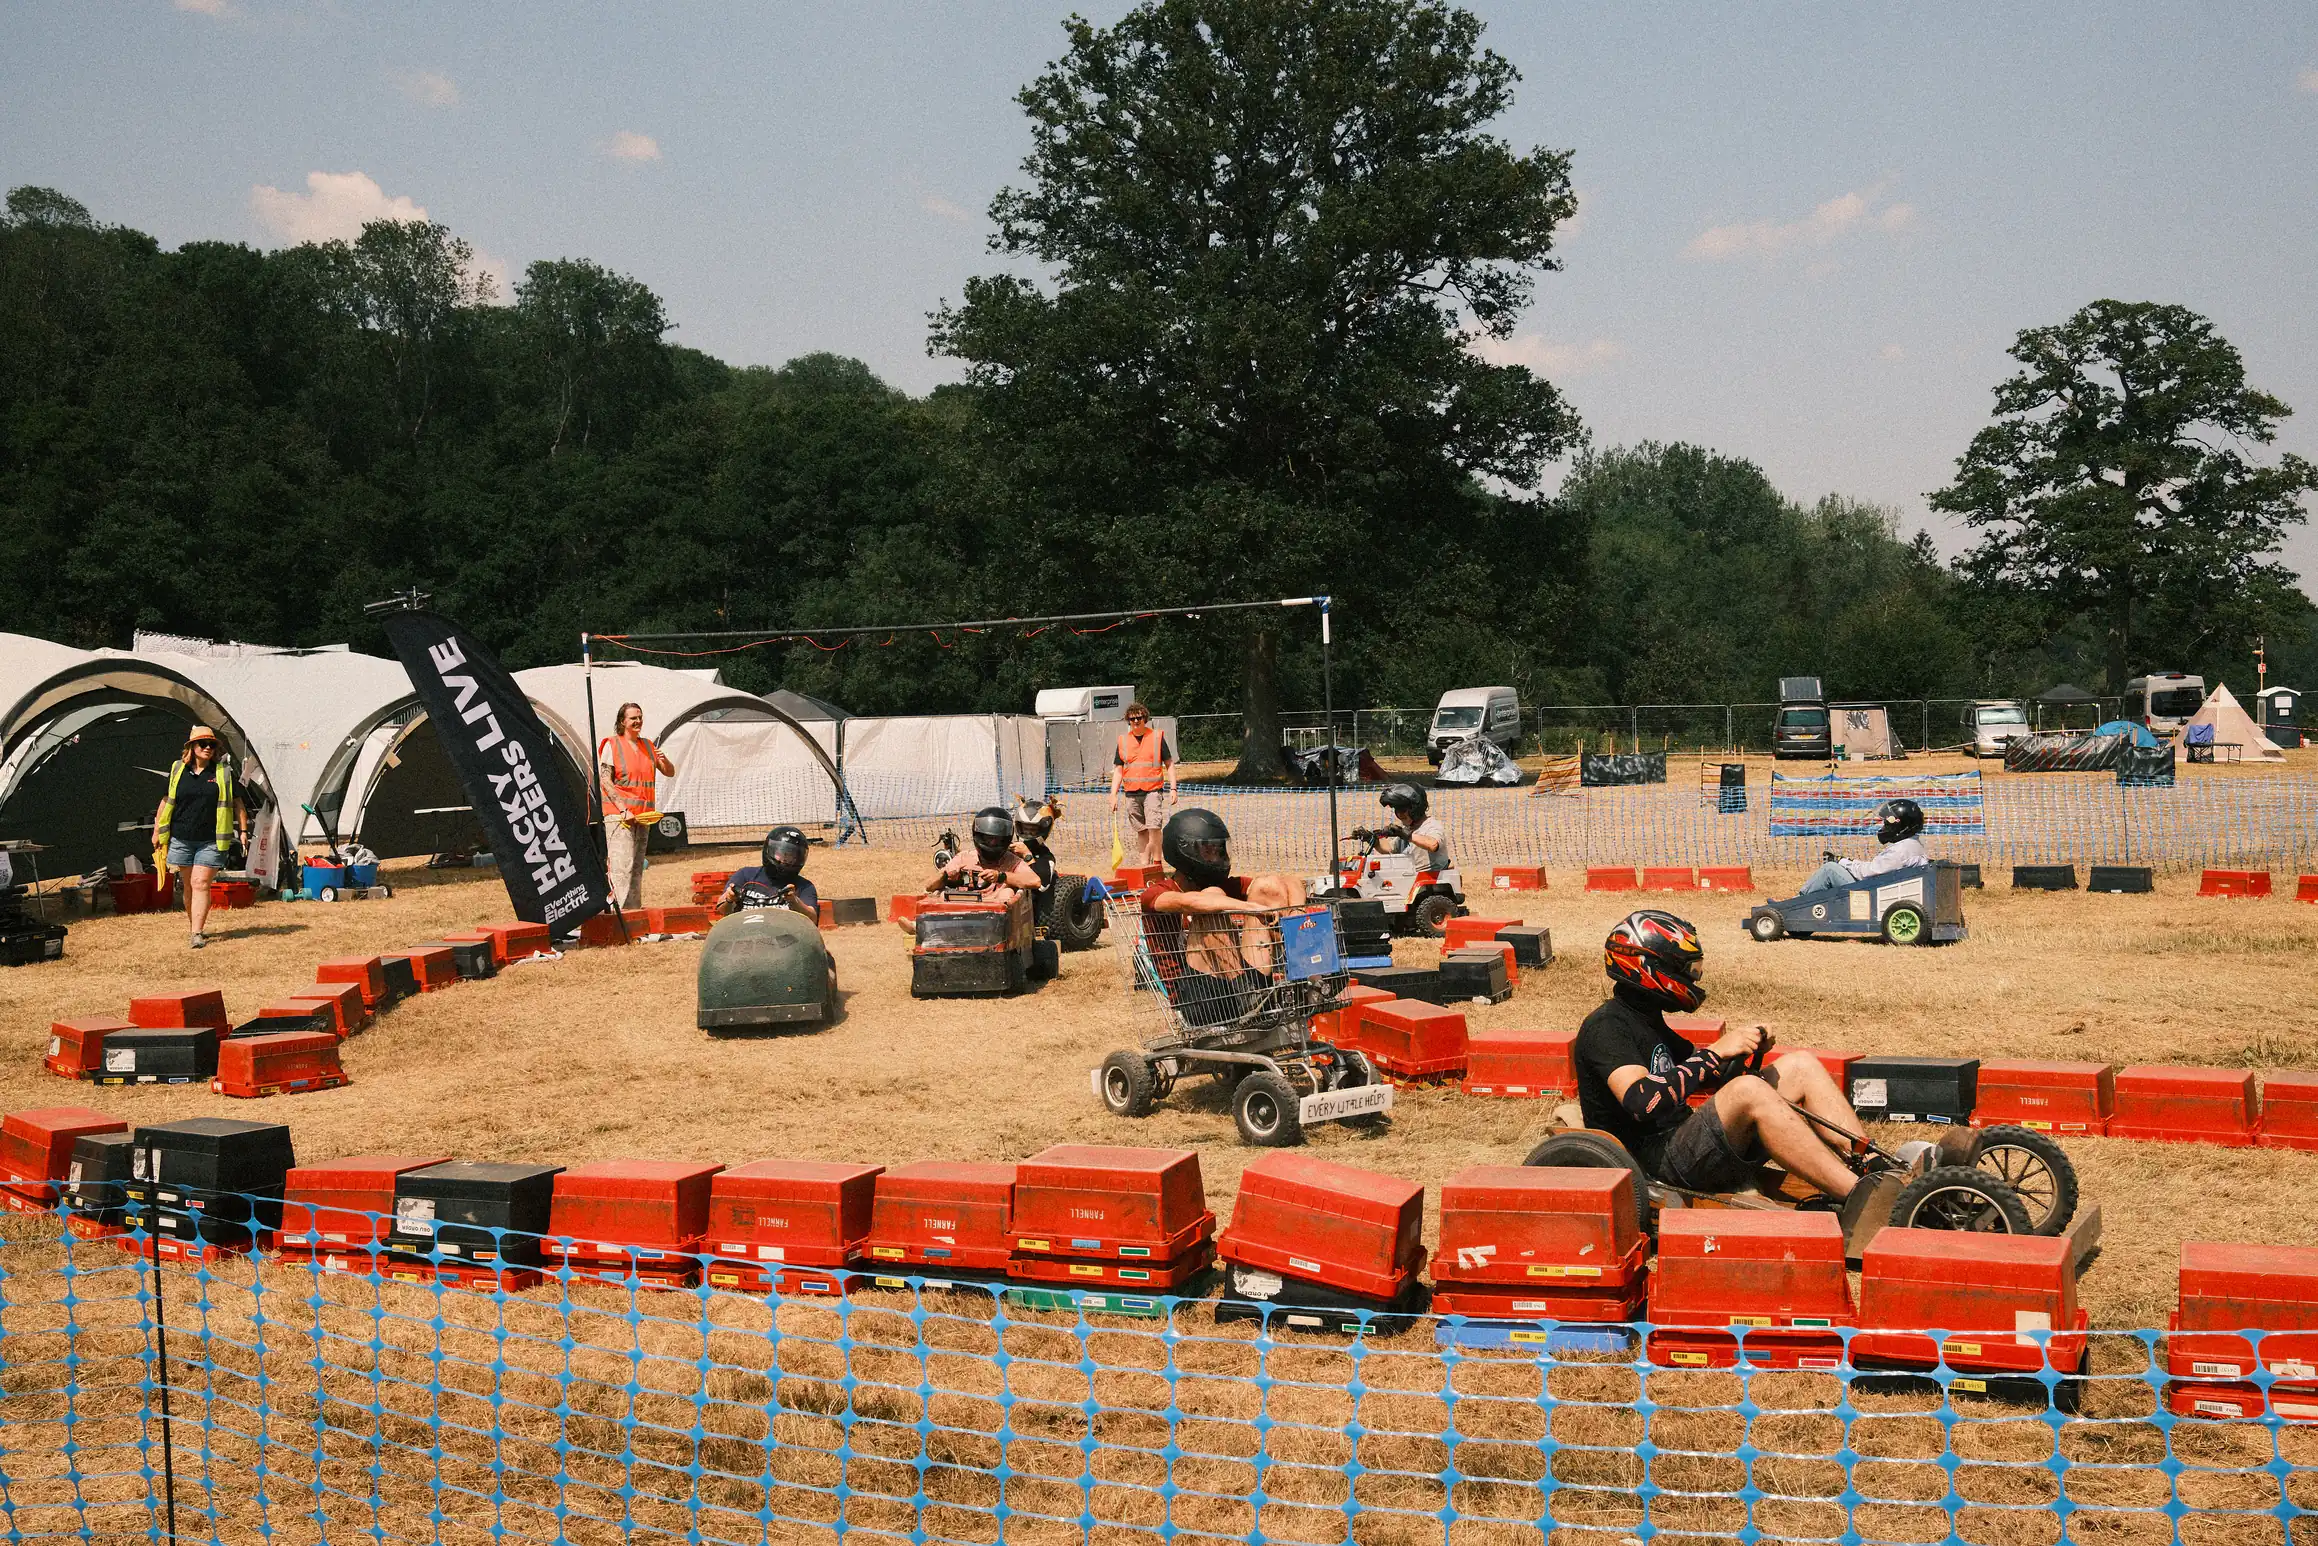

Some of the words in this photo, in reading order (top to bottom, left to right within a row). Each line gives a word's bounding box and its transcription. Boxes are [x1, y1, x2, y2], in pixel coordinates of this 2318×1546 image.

[428, 636, 505, 752] LIVE
[501, 740, 577, 883] RACERS
[487, 772, 558, 896] HACKY
[545, 890, 590, 924] Electric
[742, 914, 765, 924] 2
[1307, 1103, 1335, 1118] EVERY
[1365, 1093, 1385, 1107] HELPS
[2020, 1097, 2048, 1106] FARNELL
[757, 1216, 789, 1228] FARNELL
[1069, 1208, 1104, 1220] FARNELL
[923, 1218, 956, 1230] FARNELL
